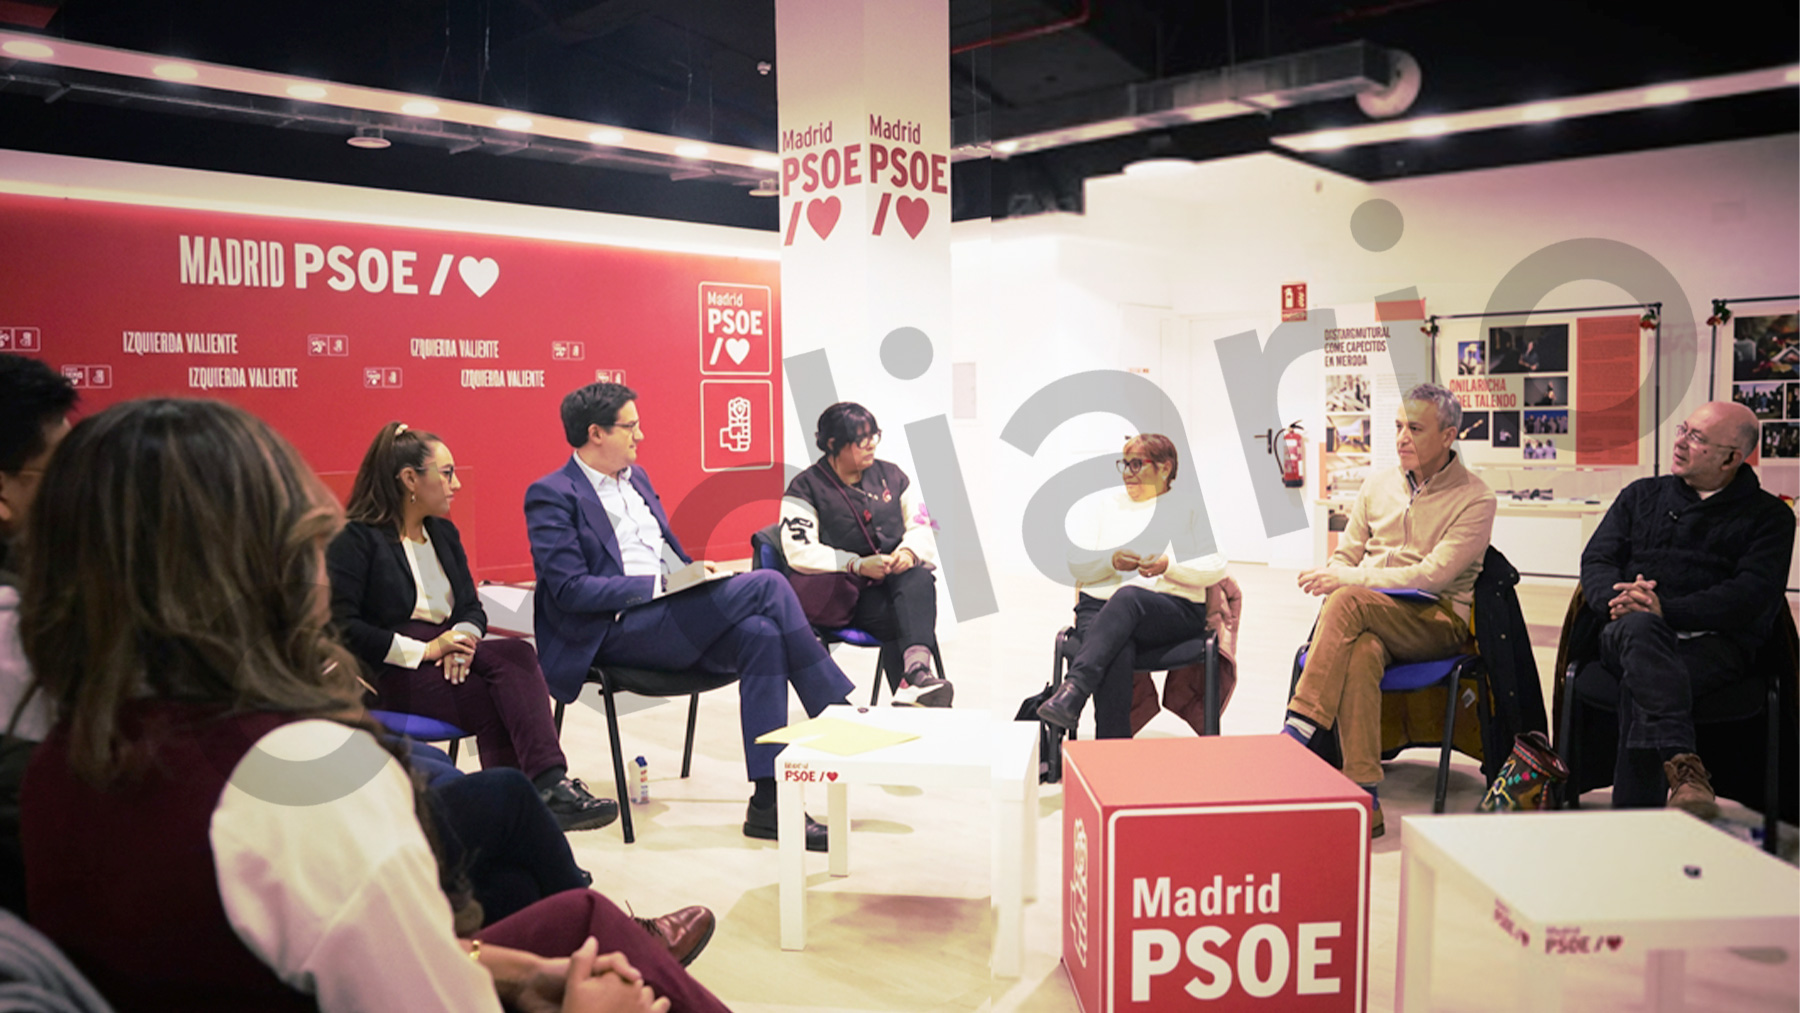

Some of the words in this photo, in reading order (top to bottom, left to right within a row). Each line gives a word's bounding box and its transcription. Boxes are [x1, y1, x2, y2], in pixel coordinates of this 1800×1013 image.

[782, 120, 833, 152] Madrid
[869, 113, 921, 145] Madrid
[782, 143, 862, 197] PSOE
[869, 143, 948, 194] PSOE
[179, 234, 285, 288] MADRID
[294, 242, 419, 296] PSOE
[707, 290, 744, 307] Madrid
[707, 308, 764, 336] PSOE
[122, 331, 184, 356] IZQUIERDA
[185, 333, 239, 355] VALIENTE
[410, 338, 457, 360] IZQUIERDA
[459, 339, 500, 359] VALIENTE
[188, 366, 246, 389] IZQUIERDA
[248, 367, 299, 389] VALIENTE
[461, 368, 505, 390] IZQUIERDA
[506, 369, 545, 388] VALIENTE
[785, 770, 816, 782] PSOE
[1132, 872, 1281, 919] Madrid
[1131, 921, 1342, 1003] PSOE
